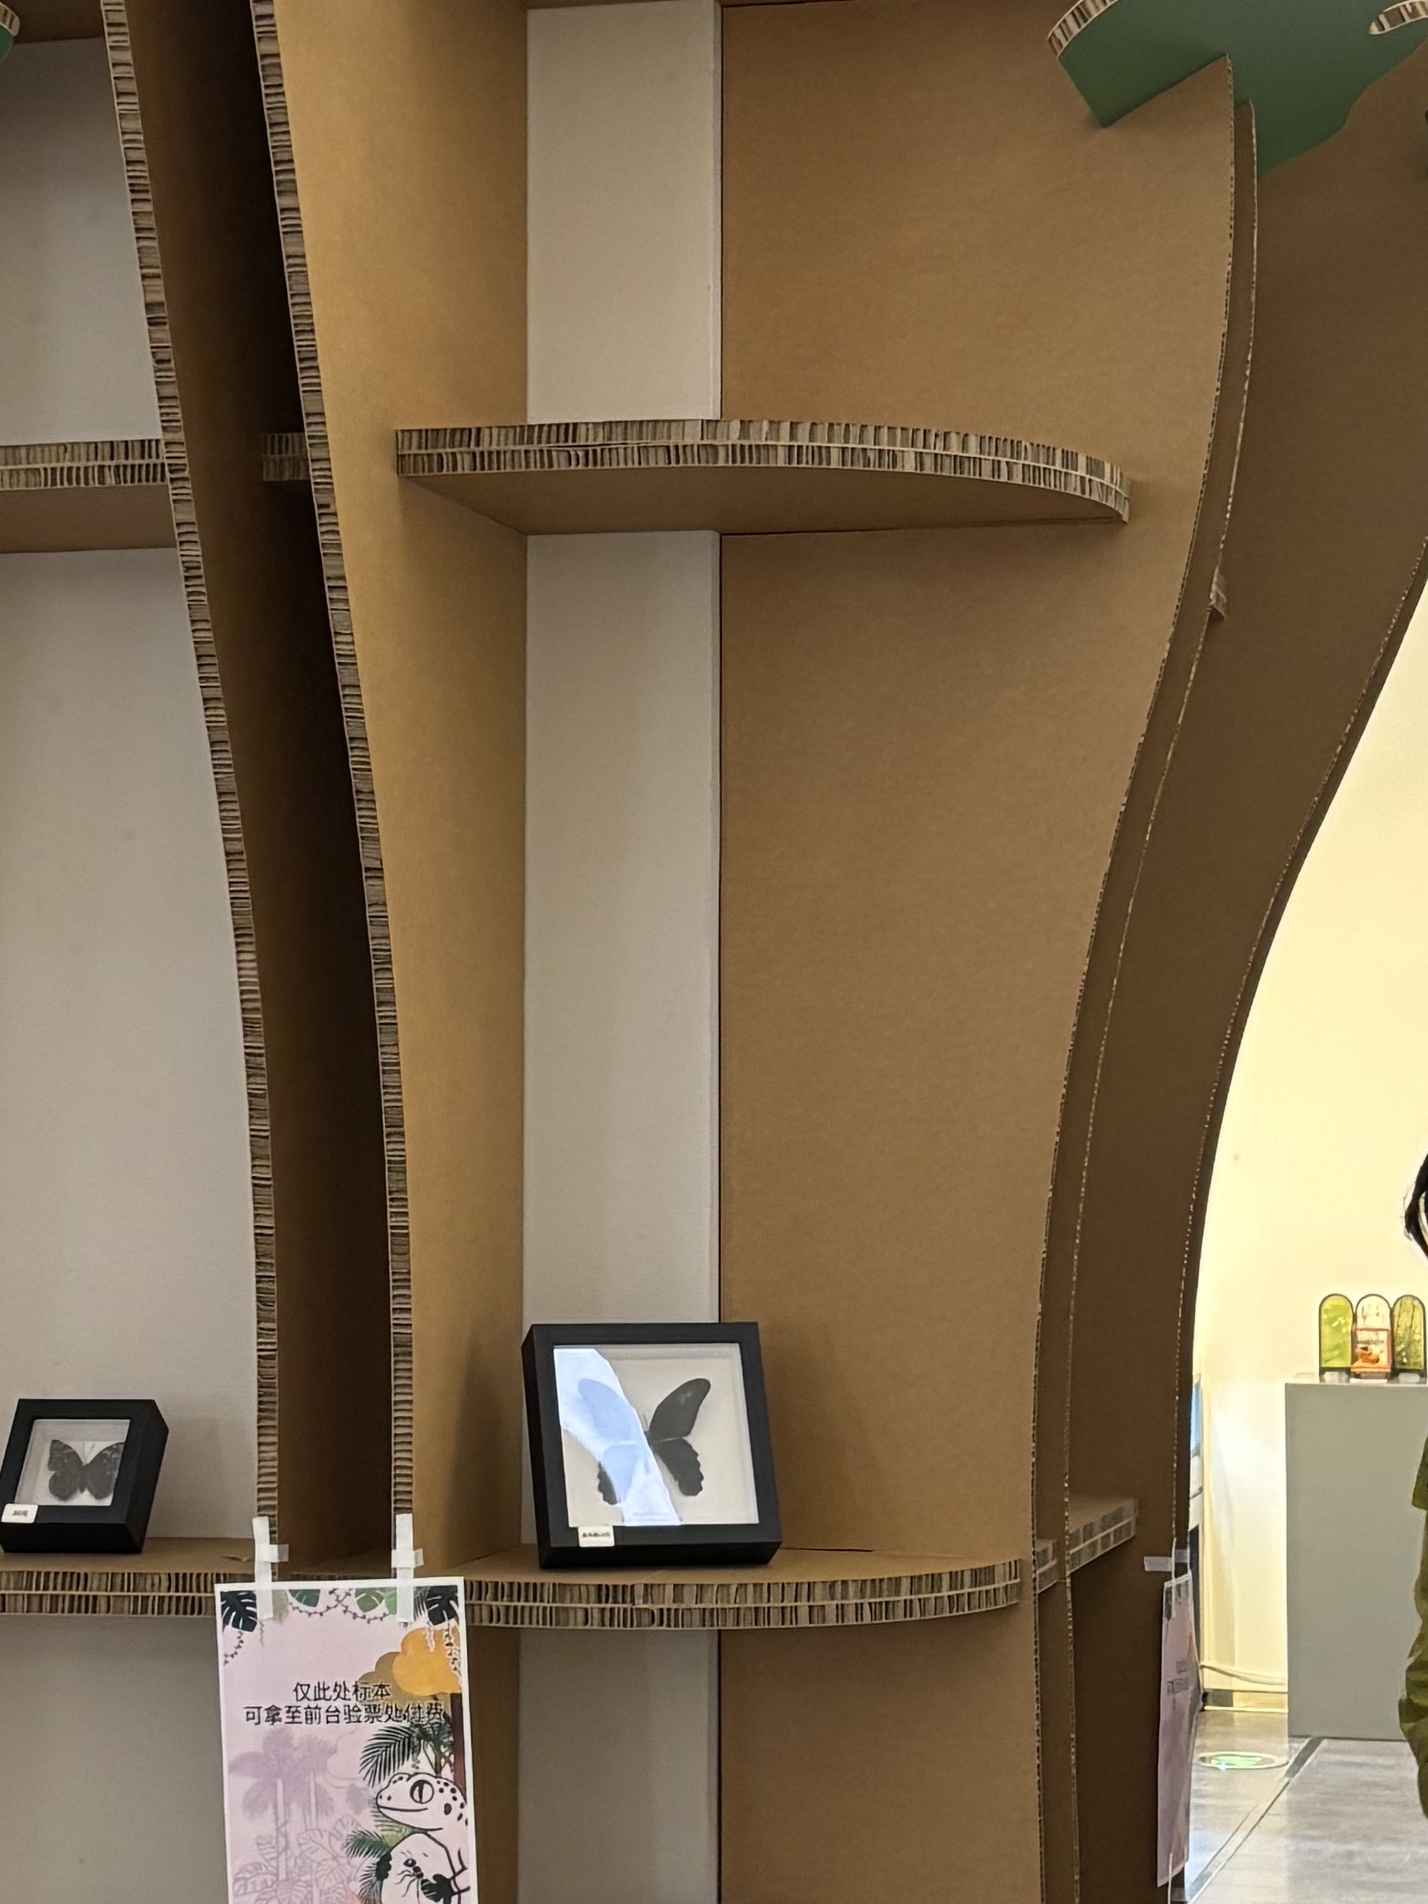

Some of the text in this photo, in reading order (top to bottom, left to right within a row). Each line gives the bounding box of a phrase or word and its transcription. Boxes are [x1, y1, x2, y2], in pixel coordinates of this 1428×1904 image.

[293, 1680, 391, 1702] 仅此处标本
[243, 1703, 445, 1726] 可拿至前台验票处付费
